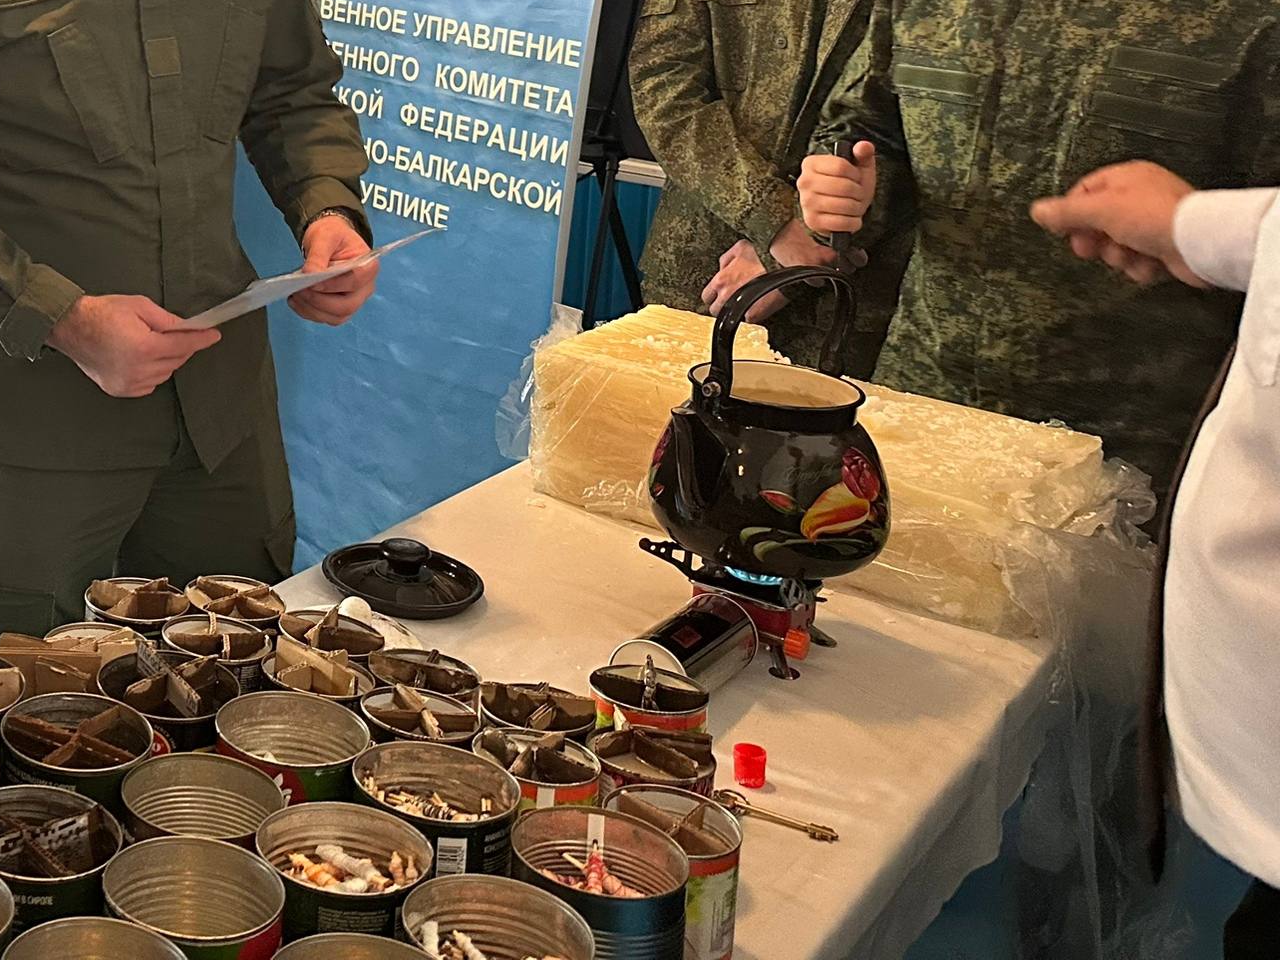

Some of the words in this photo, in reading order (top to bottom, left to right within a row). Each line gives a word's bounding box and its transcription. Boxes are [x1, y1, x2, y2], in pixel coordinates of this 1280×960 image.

[412, 12, 582, 68] УПРАВЛЕНИЕ
[434, 63, 574, 118] КОМИТЕТА
[332, 86, 383, 119] КОЙ
[399, 102, 569, 167] ФЕДЕРАЦИИ
